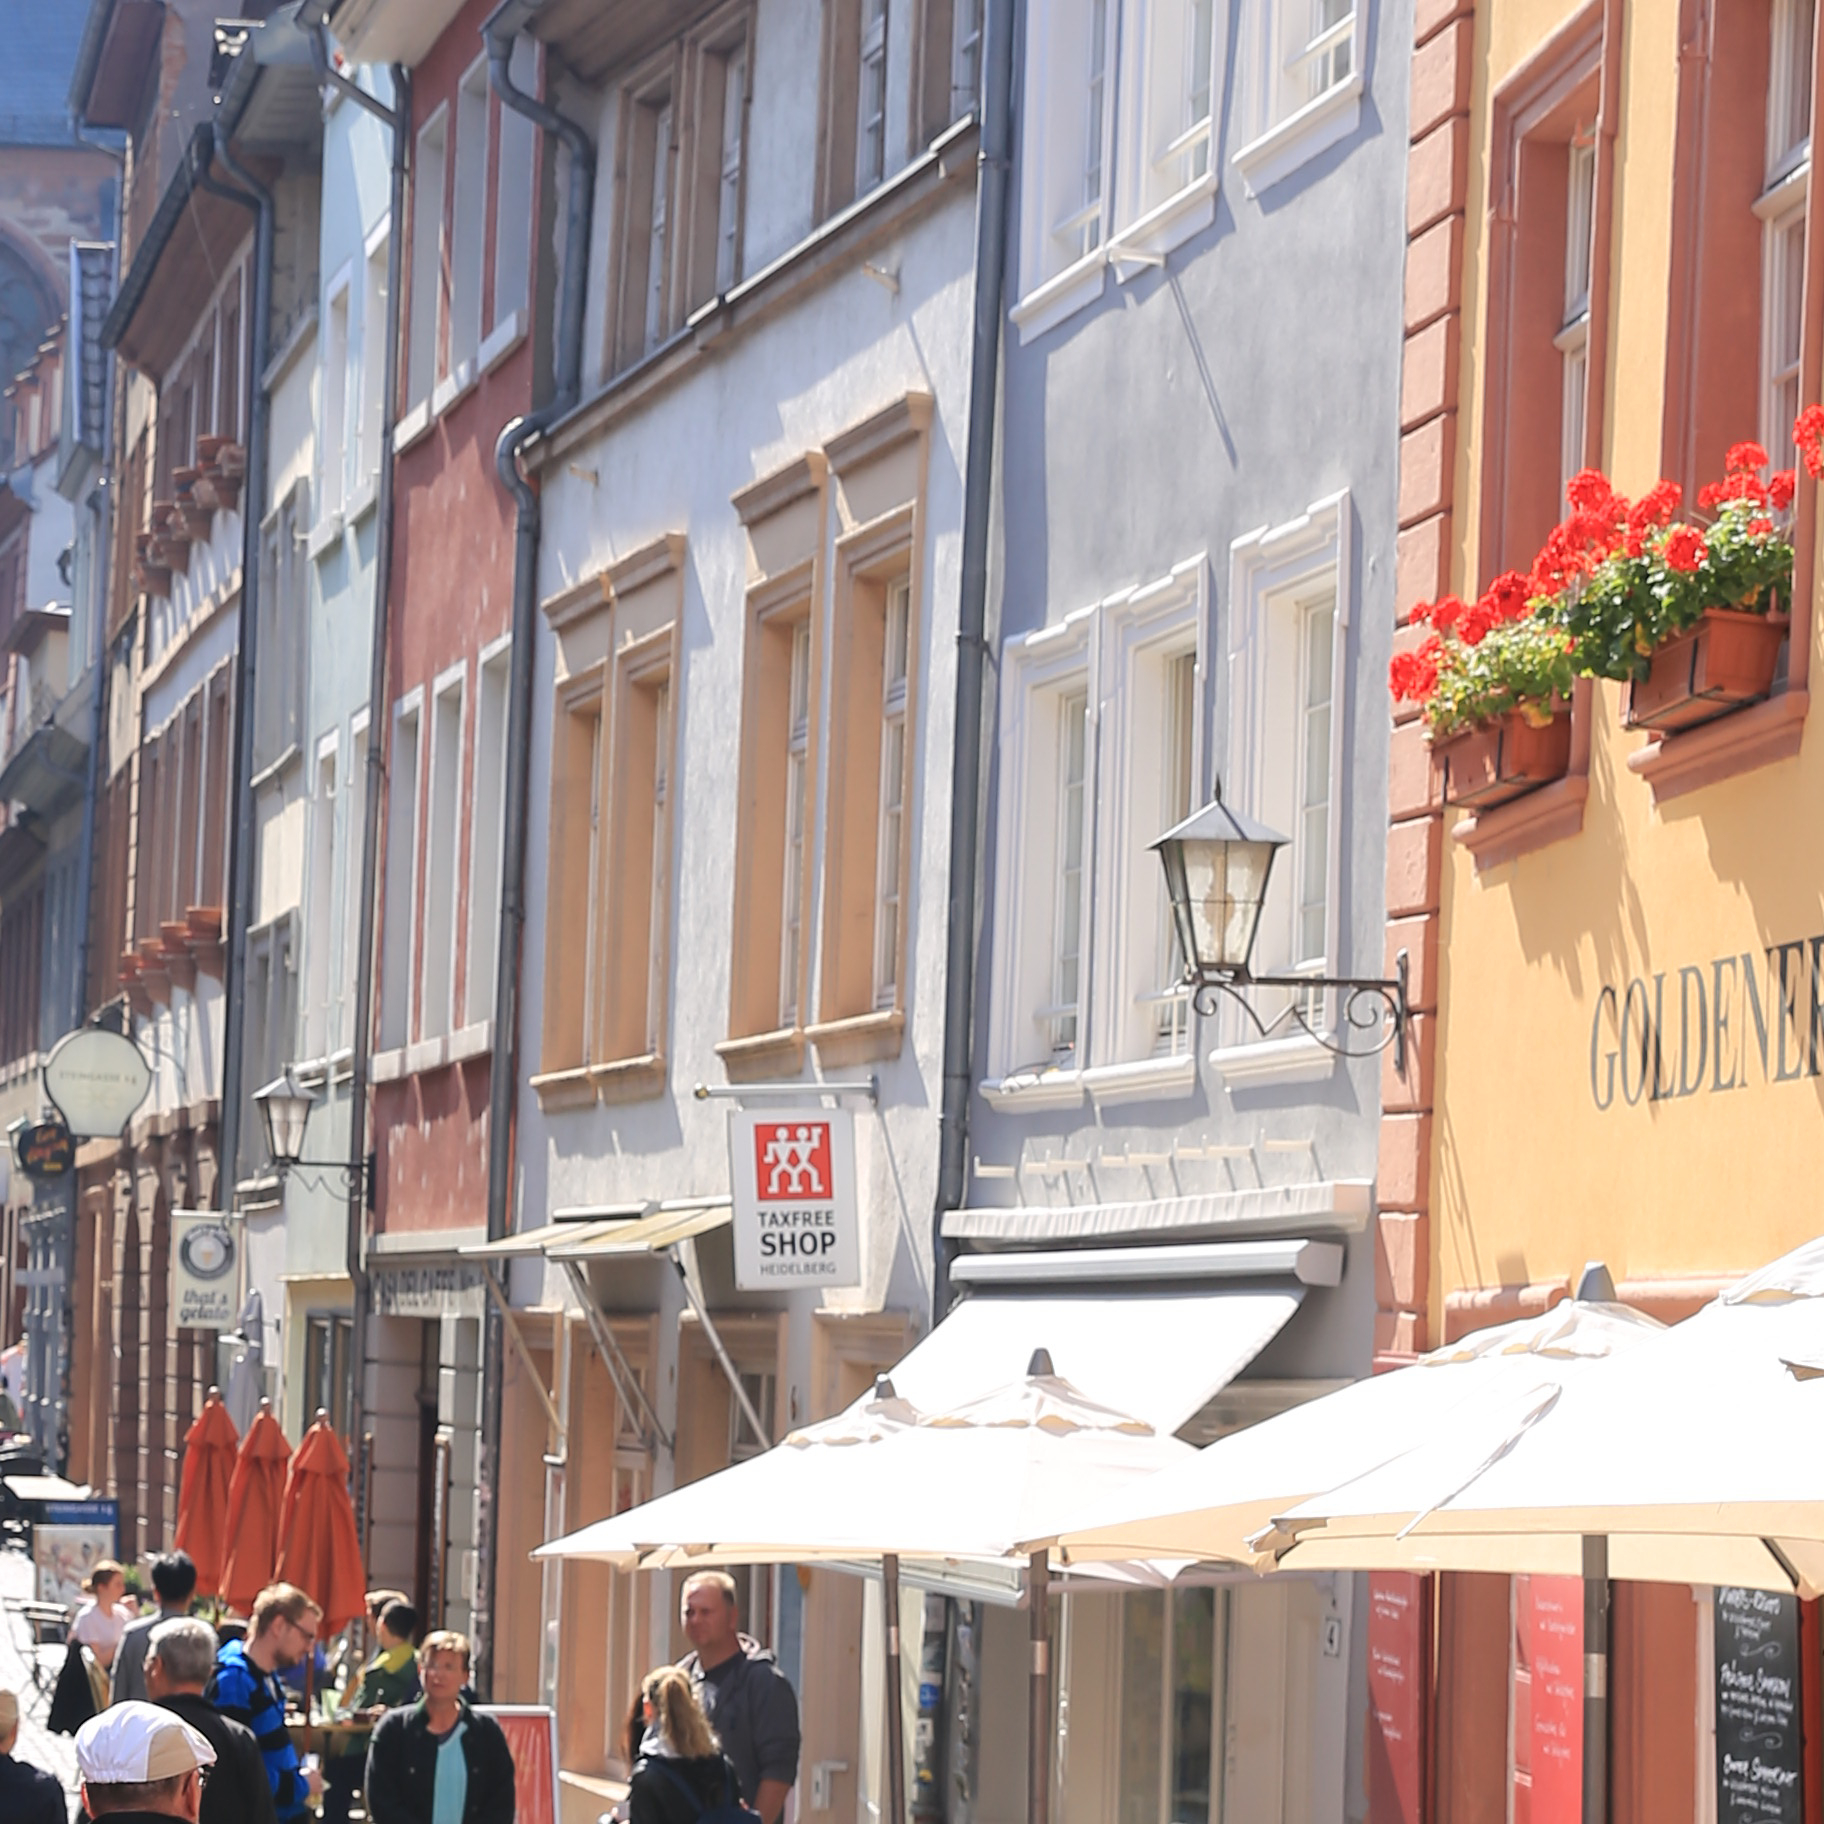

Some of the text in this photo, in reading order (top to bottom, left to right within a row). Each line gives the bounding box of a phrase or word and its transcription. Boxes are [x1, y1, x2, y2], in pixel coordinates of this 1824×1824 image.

[757, 1210, 835, 1227] TAXFREE
[760, 1231, 836, 1257] SHOP
[760, 1261, 836, 1276] HEIDELBERG
